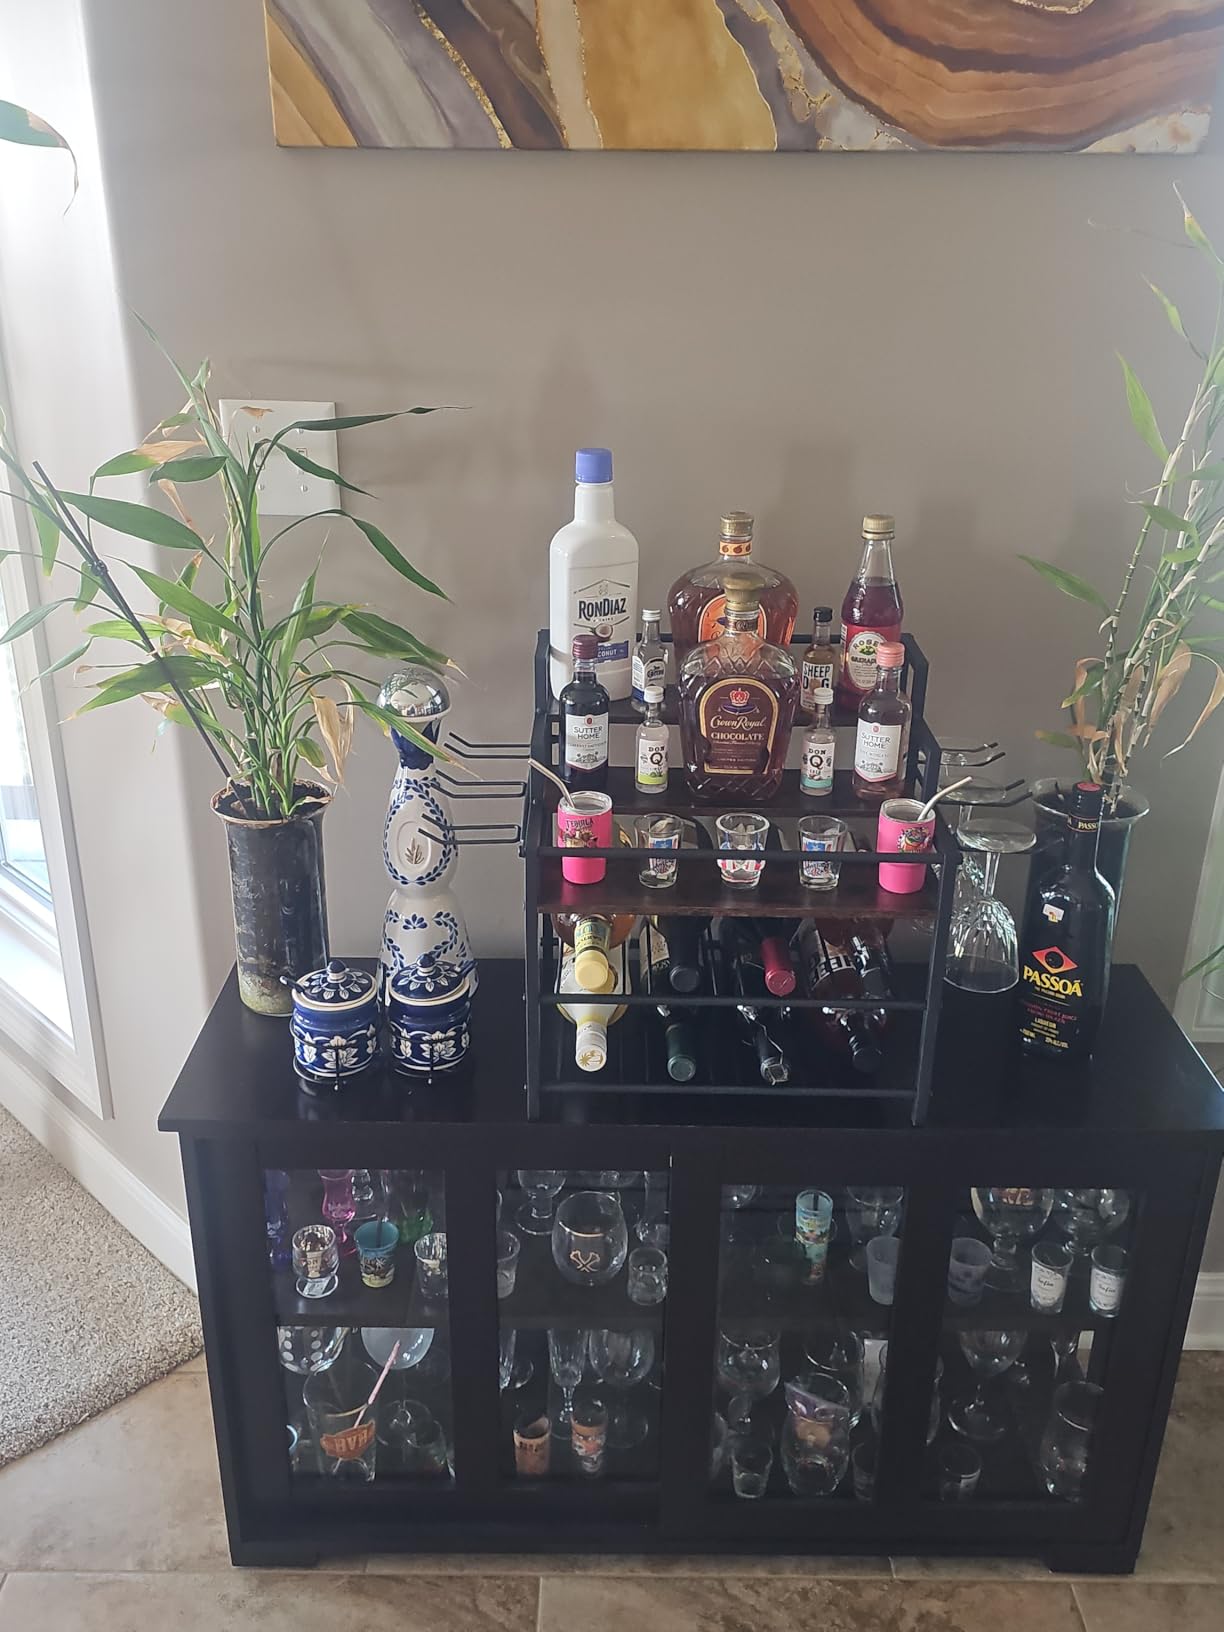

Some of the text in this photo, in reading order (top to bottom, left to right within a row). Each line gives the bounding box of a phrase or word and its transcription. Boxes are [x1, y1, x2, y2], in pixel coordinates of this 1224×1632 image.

[803, 663, 831, 678] SHEEP
[710, 715, 767, 731] Crown Royal
[573, 726, 602, 734] SUTTER
[710, 731, 765, 741] CHOCOLATE
[861, 732, 891, 743] SUTTER
[863, 740, 887, 749] HOME
[649, 752, 664, 767] Q
[809, 755, 823, 770] Q
